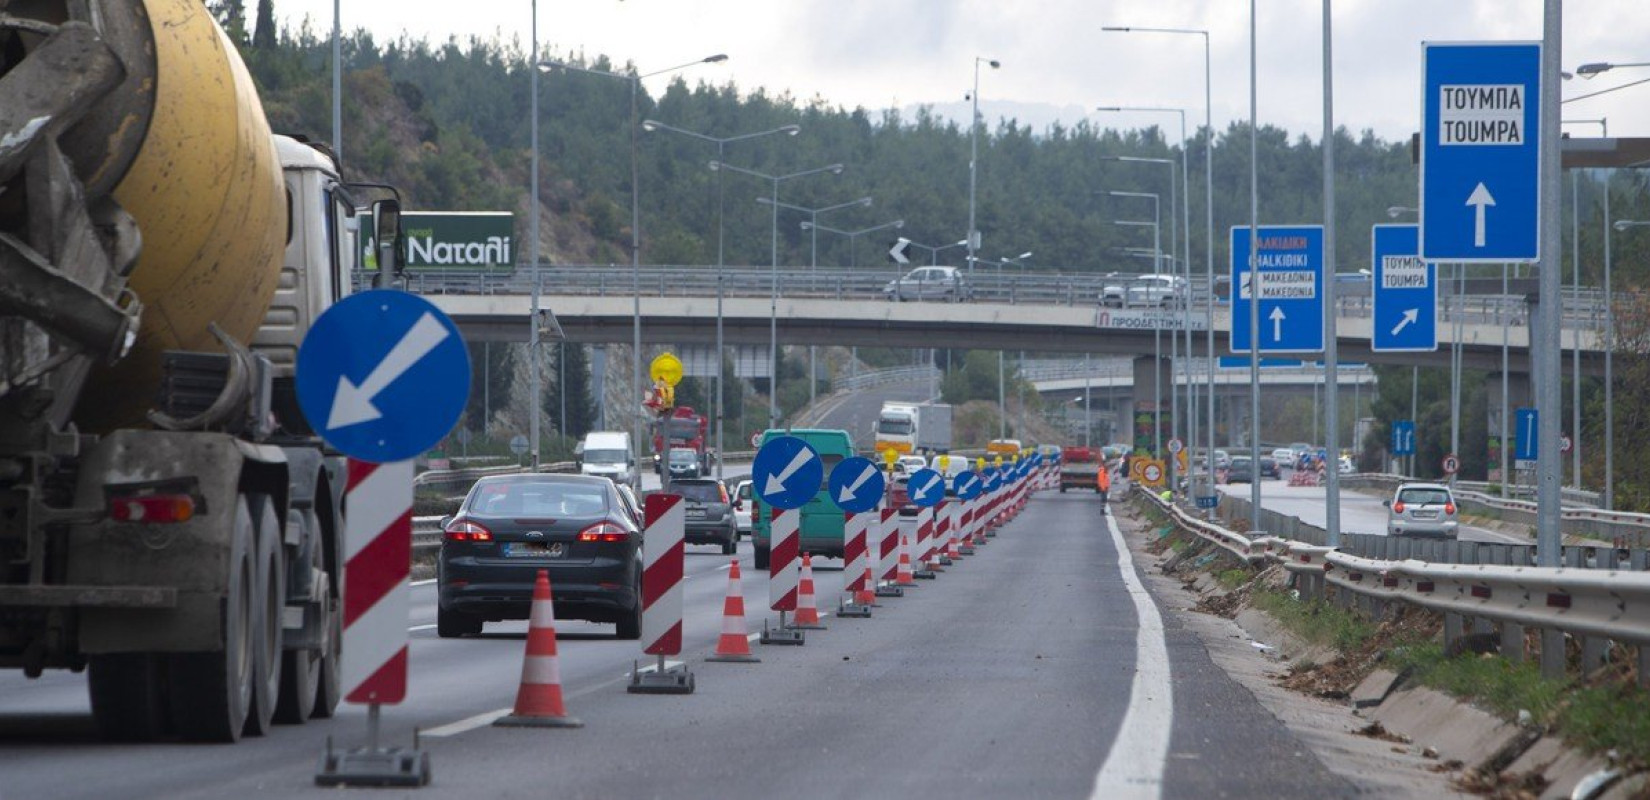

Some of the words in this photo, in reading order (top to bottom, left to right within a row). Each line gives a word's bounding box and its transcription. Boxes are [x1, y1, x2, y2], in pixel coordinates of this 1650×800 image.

[1443, 87, 1522, 110] ΤΟΥΜΠΑ
[1443, 120, 1520, 143] TOUMPA
[1255, 236, 1308, 249] ΑΛΚΙΔΙΚΗ
[1384, 274, 1426, 287] TOUMPA
